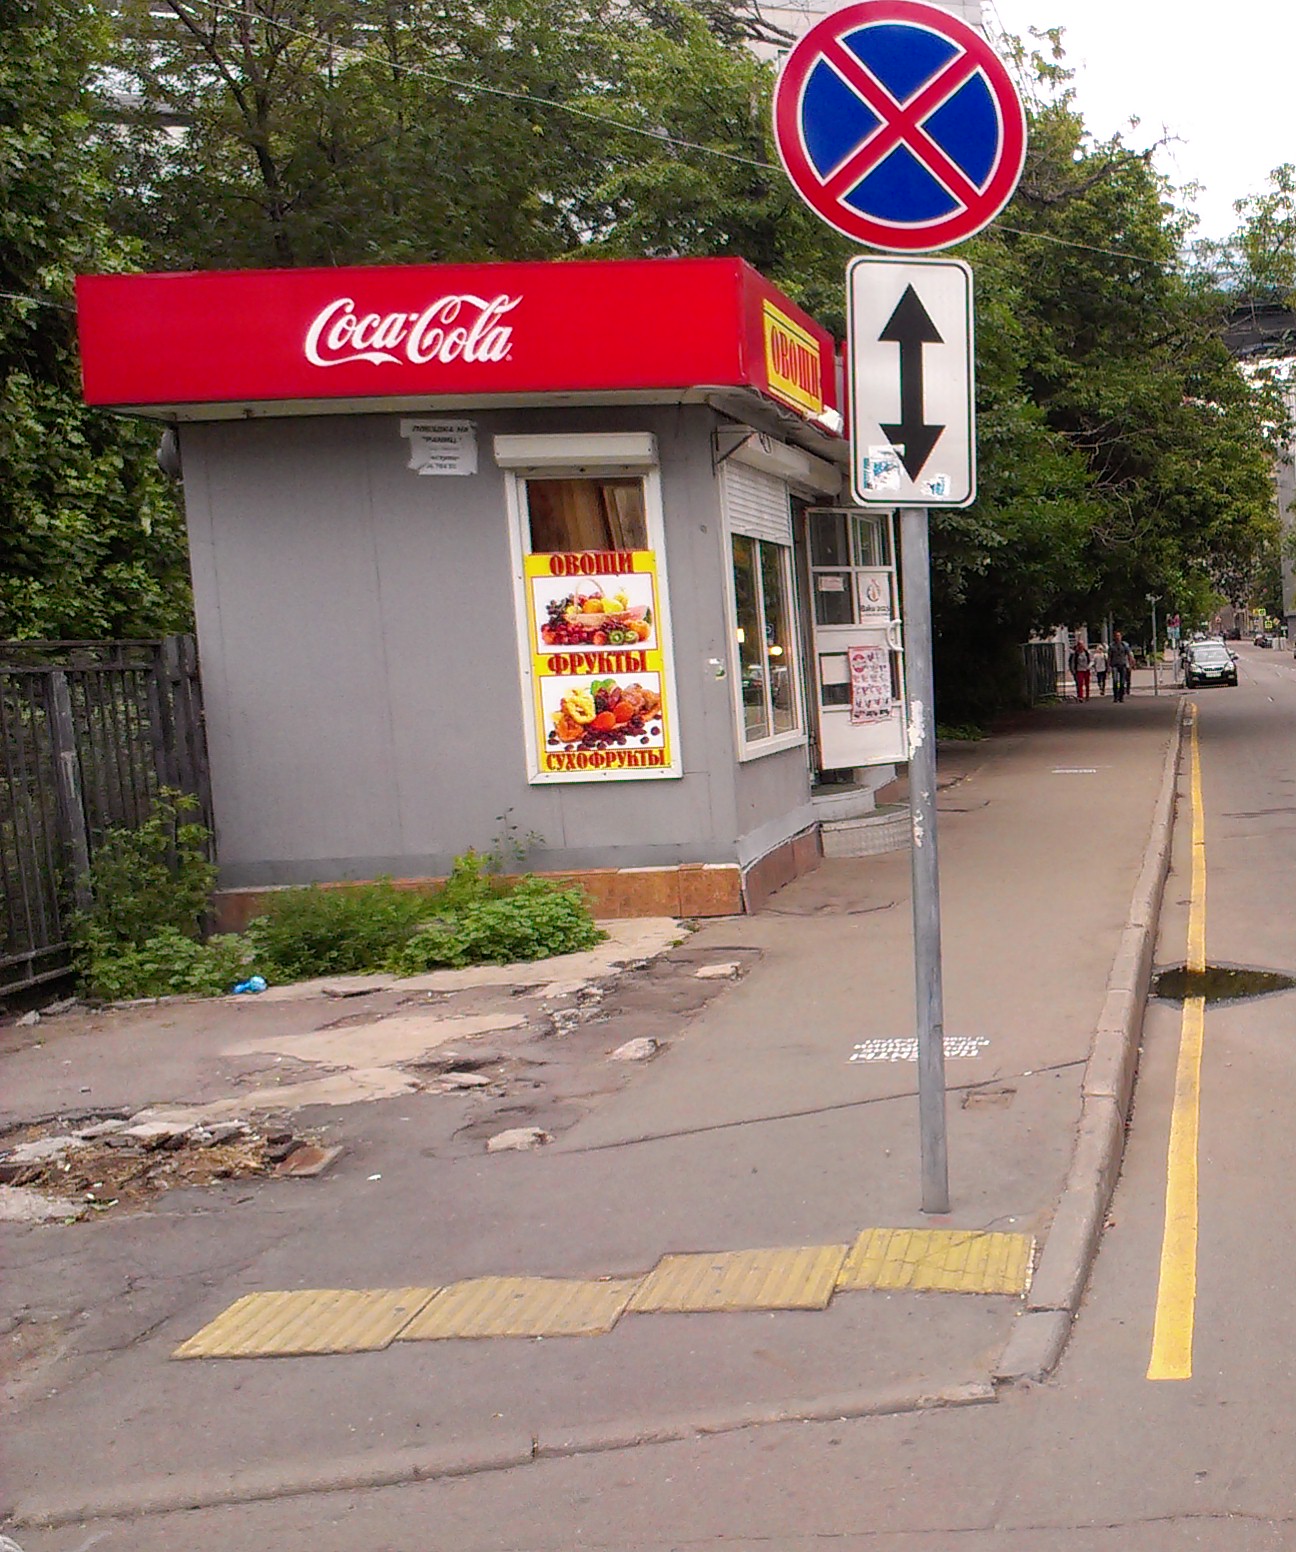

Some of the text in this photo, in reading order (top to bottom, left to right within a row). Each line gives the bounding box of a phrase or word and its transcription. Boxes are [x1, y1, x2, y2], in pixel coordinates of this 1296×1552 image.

[304, 294, 523, 366] Coca-Cola
[771, 323, 820, 401] ОВОЩИ
[549, 552, 634, 576] ОВОЩИ
[547, 650, 647, 674] ФРУКТЫ
[546, 749, 666, 770] СУХОФРУКТЫ
